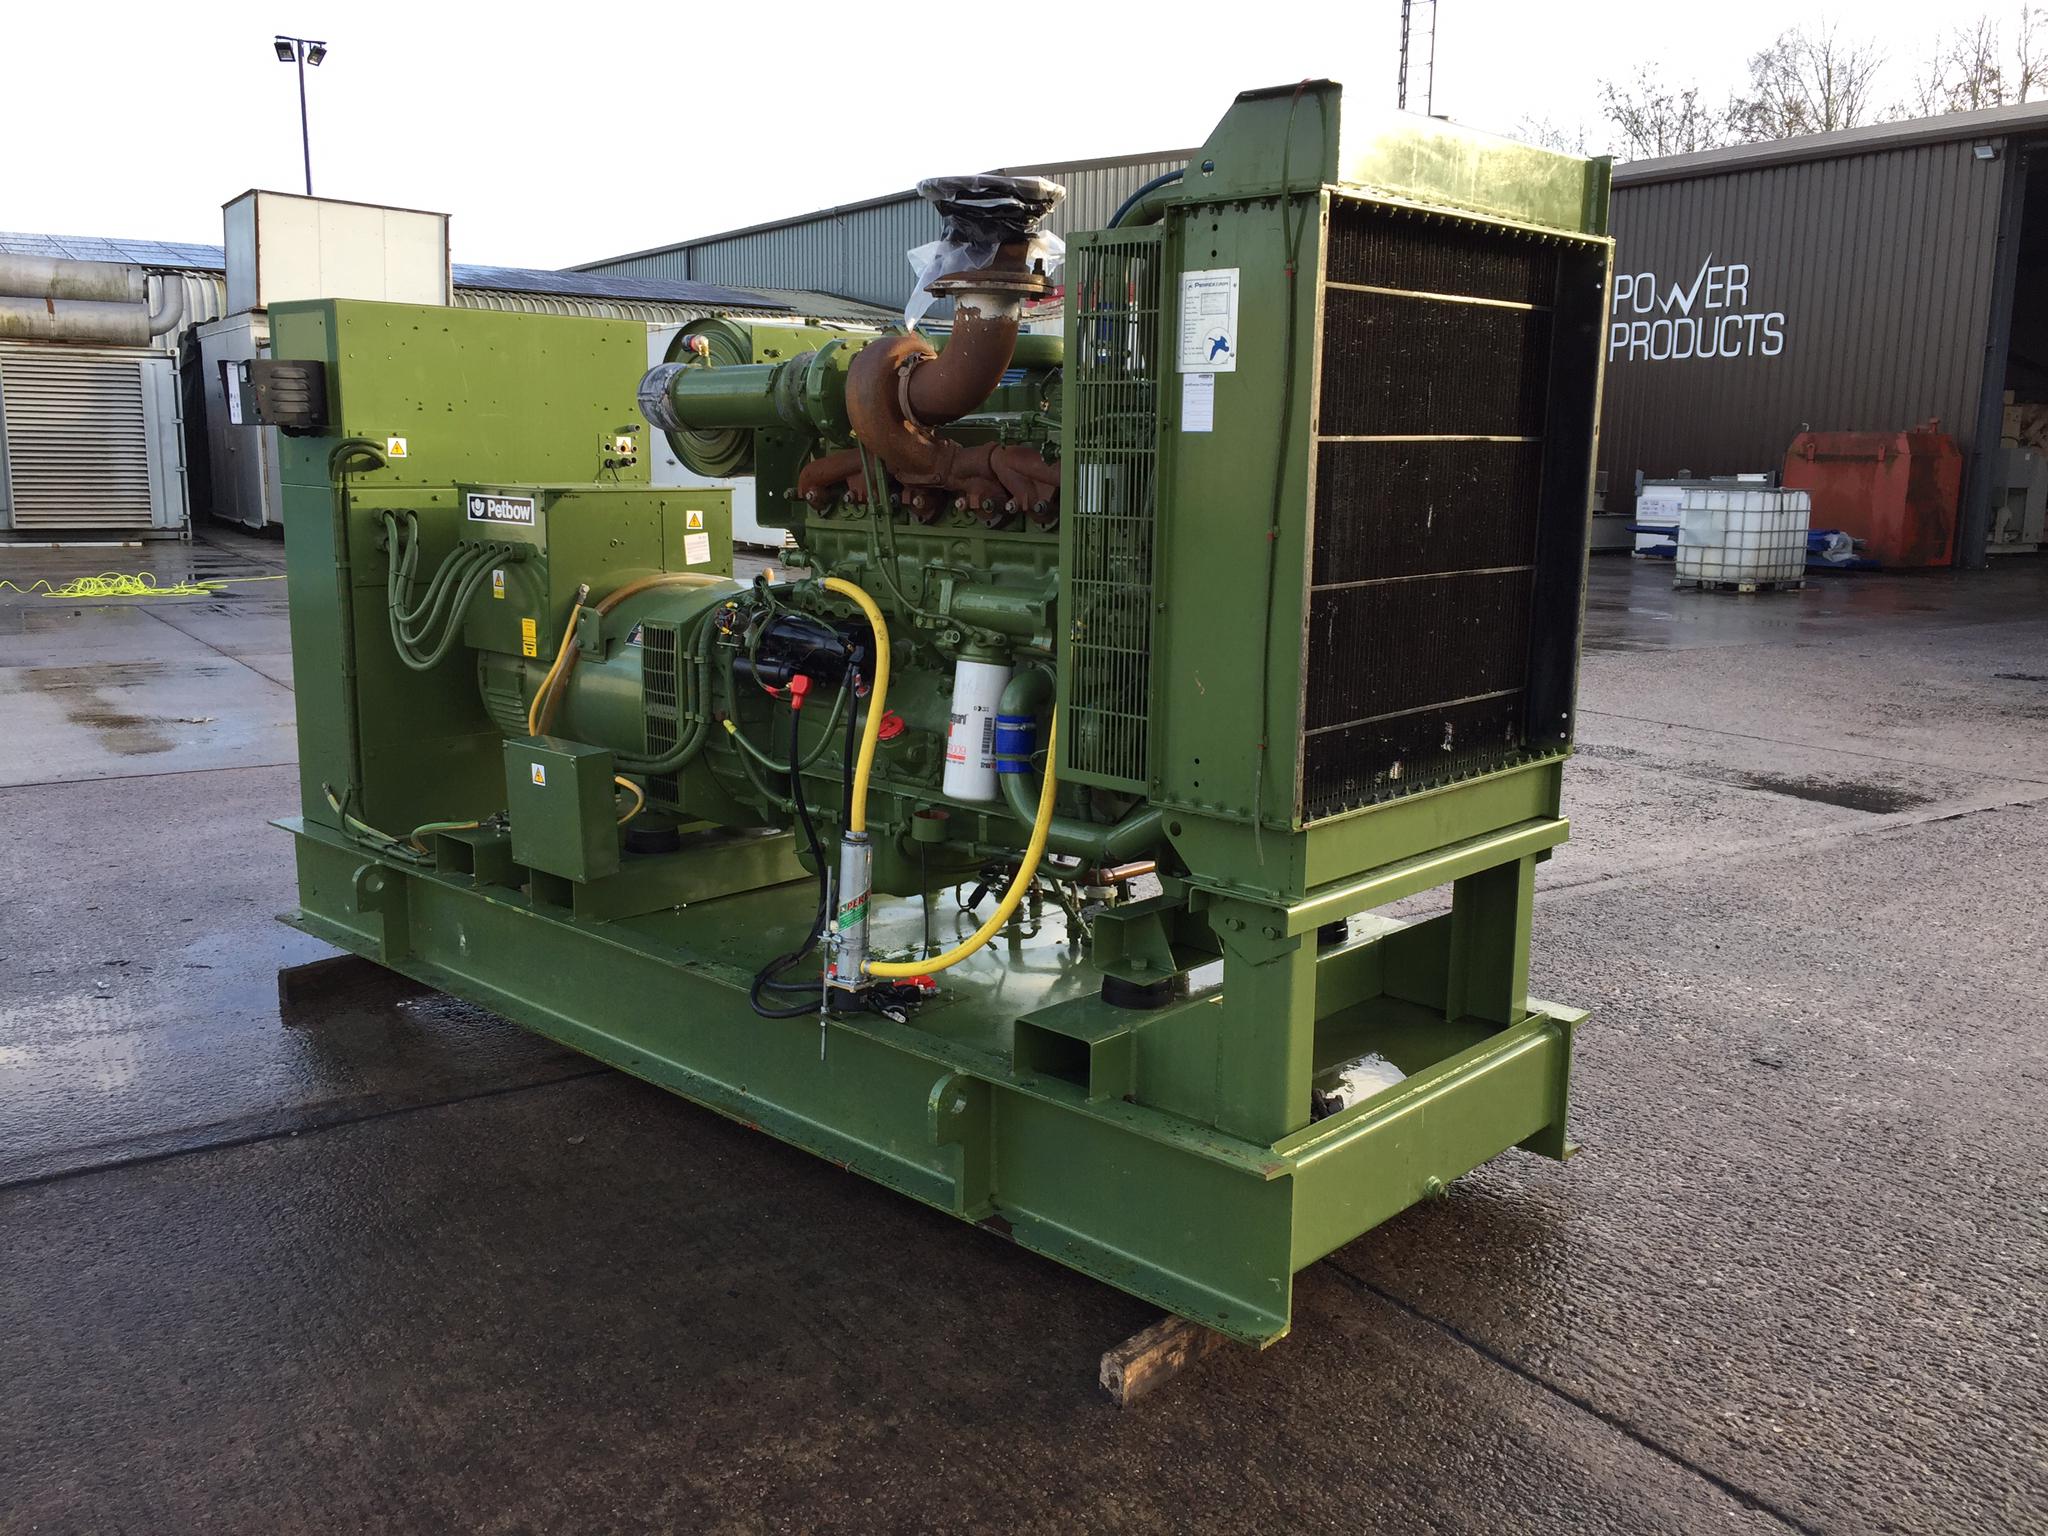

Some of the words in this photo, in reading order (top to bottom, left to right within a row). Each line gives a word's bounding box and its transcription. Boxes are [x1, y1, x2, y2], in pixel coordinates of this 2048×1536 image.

[1613, 253, 1749, 316] POWER
[1609, 312, 1785, 362] PRODUCTS
[488, 500, 530, 520] Petbow
